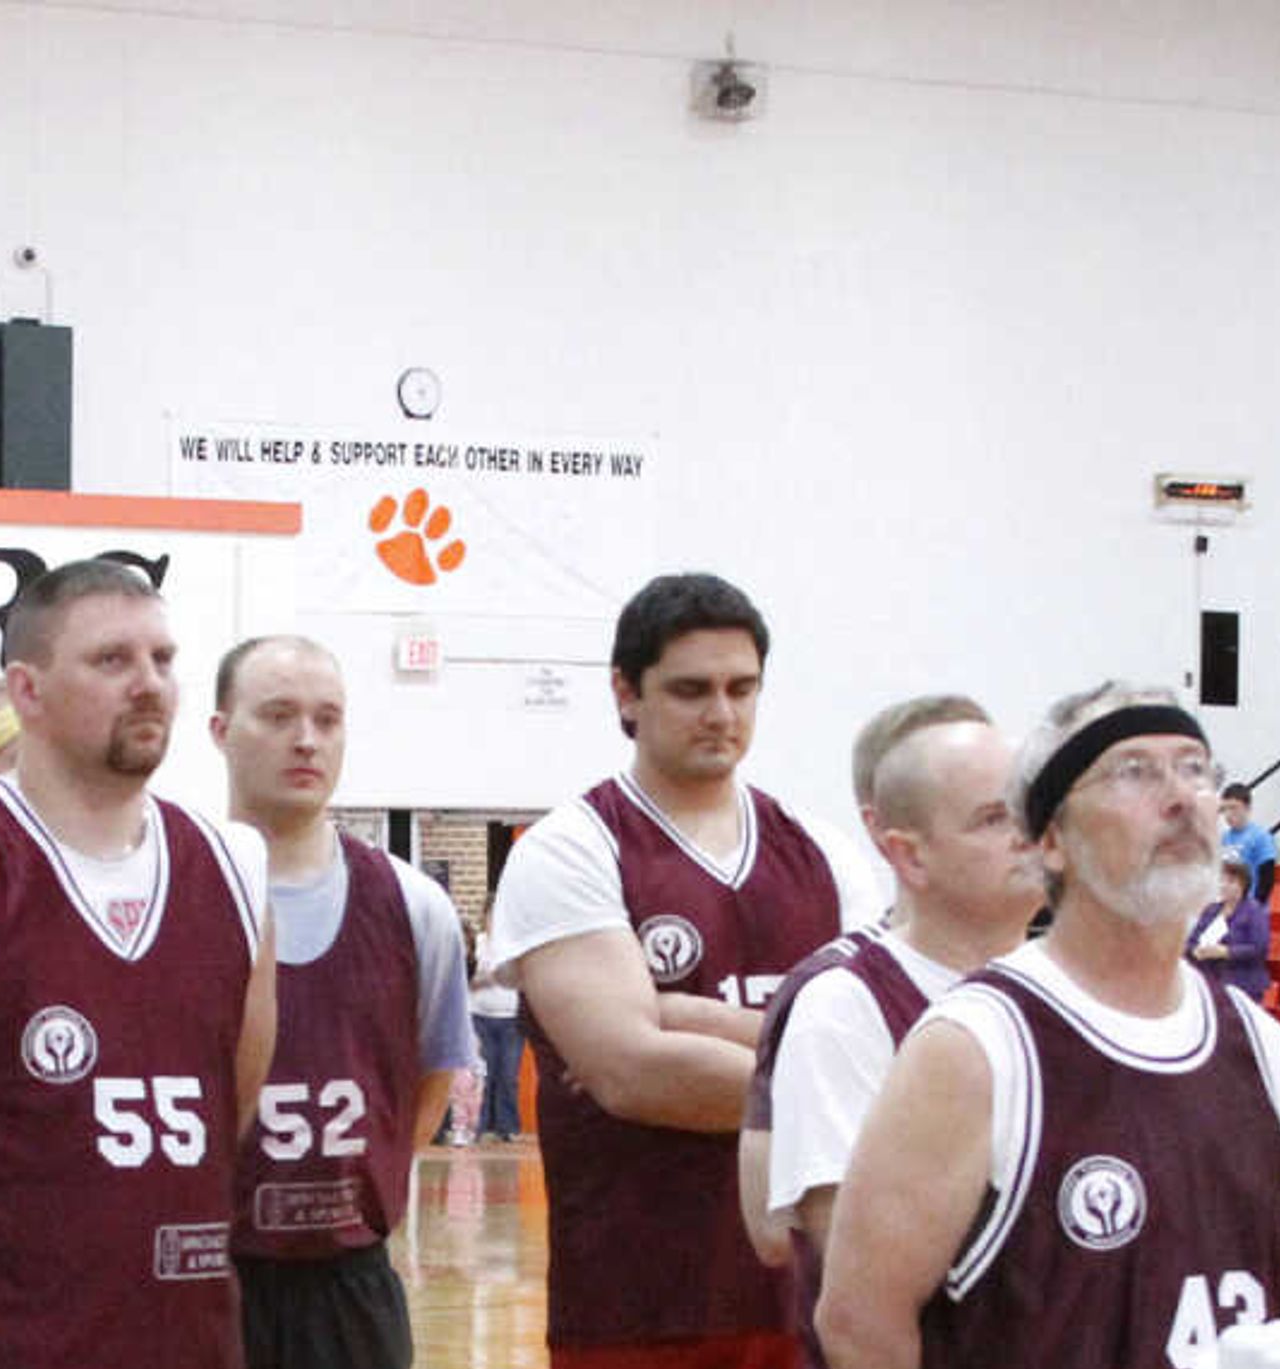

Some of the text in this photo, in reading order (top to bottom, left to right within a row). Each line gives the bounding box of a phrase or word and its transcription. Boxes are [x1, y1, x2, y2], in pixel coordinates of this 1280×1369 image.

[178, 436, 207, 461] WE
[215, 437, 254, 462] WILL
[261, 440, 305, 464] HELP
[311, 441, 321, 465] &
[330, 441, 407, 466] SUPPORT
[465, 446, 520, 472] OTHER
[527, 449, 544, 473] IN
[550, 451, 603, 476] EVERY
[611, 452, 644, 479] WAY
[92, 1075, 207, 1168] 55
[258, 1079, 367, 1160] 52
